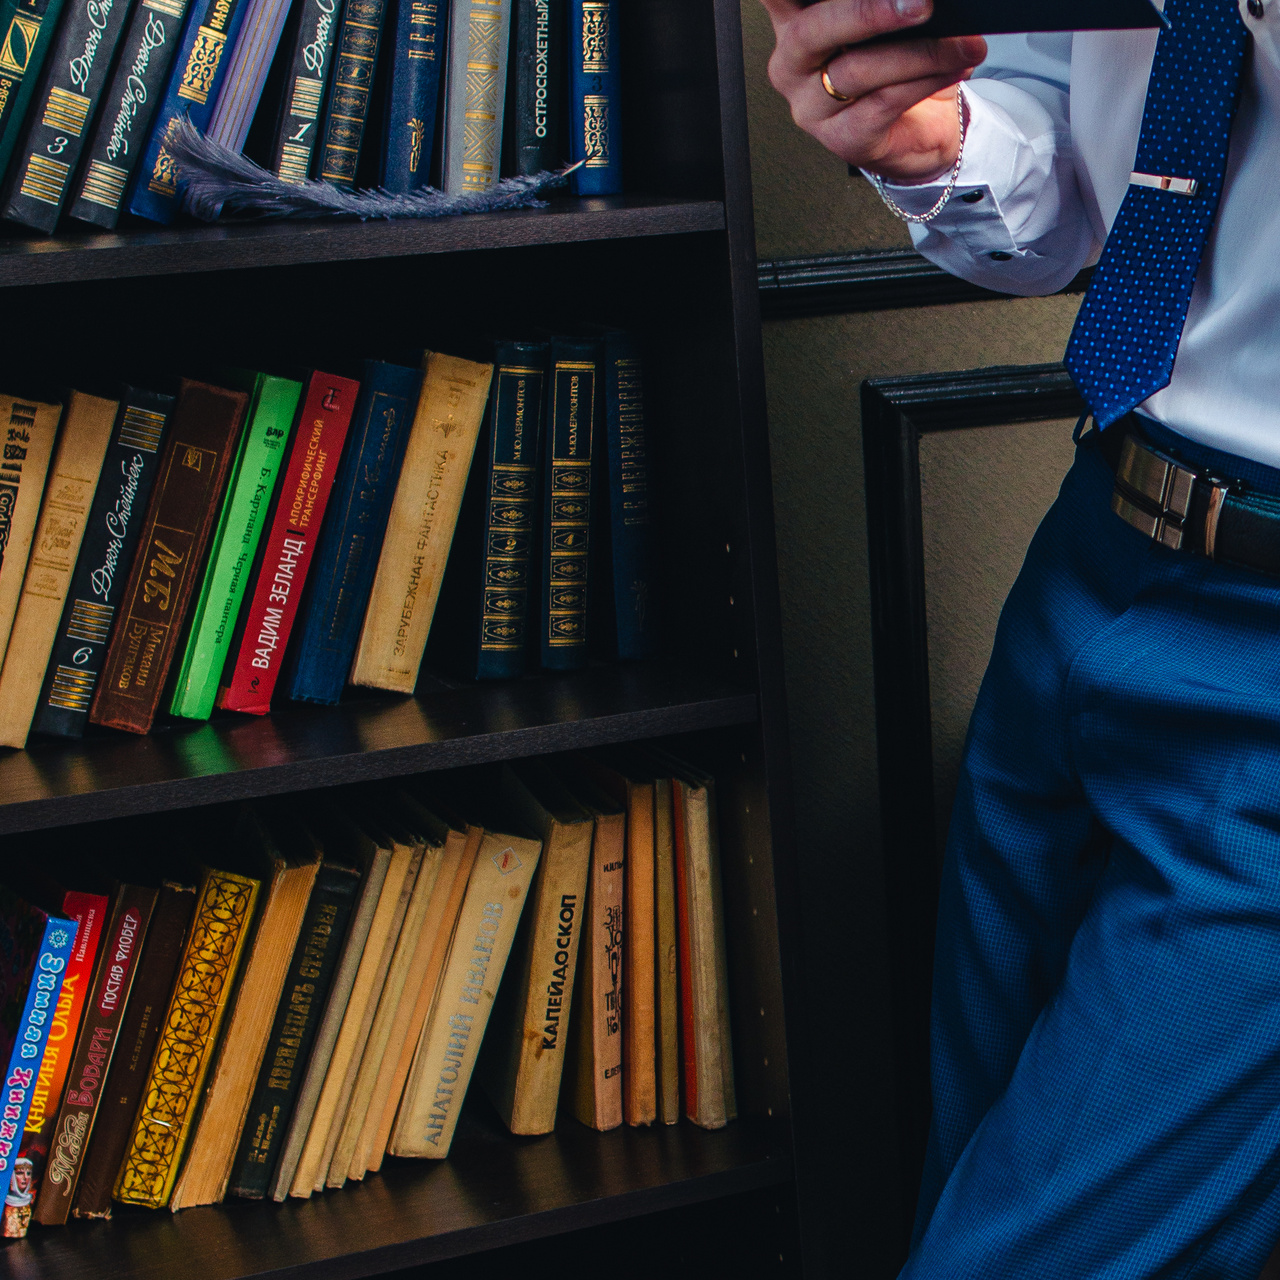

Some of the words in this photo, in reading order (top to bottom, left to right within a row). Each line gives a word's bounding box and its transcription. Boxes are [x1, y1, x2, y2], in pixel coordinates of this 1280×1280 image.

[70, 28, 103, 93] Джон
[131, 12, 166, 78] Джон
[303, 13, 333, 80] Джон
[47, 136, 69, 155] 3
[105, 74, 147, 162] Стейнбек
[614, 359, 648, 494] МЕРЕЖКОВСКИЙ
[106, 453, 145, 540] Стейнбек
[289, 419, 325, 527] АПОКРИФИЧЕСКИЙ
[299, 449, 328, 528] ТРАНСЕРФИНГ
[241, 483, 267, 544] Картланд
[91, 538, 124, 602] Джон
[392, 556, 427, 658] ЗАРУБЕЖНАЯ
[416, 450, 450, 552] ФАНТАСТИКА
[214, 597, 236, 644] пантера
[252, 608, 284, 669] ВАДИМ
[269, 538, 306, 605] ЗЕЛАНД
[118, 623, 148, 691] Булгаков
[135, 628, 164, 686] Михаил
[75, 908, 96, 962] Павлищева
[101, 964, 124, 1011] ГЮСТАВ
[115, 914, 138, 962] ФЛОБЕР
[21, 952, 66, 1060] Зимняя
[268, 983, 316, 1091] ДВЕНАДЦАТЬ
[422, 1014, 475, 1148] АНАТОЛИЙ
[458, 902, 505, 1005] ИВАНОВ
